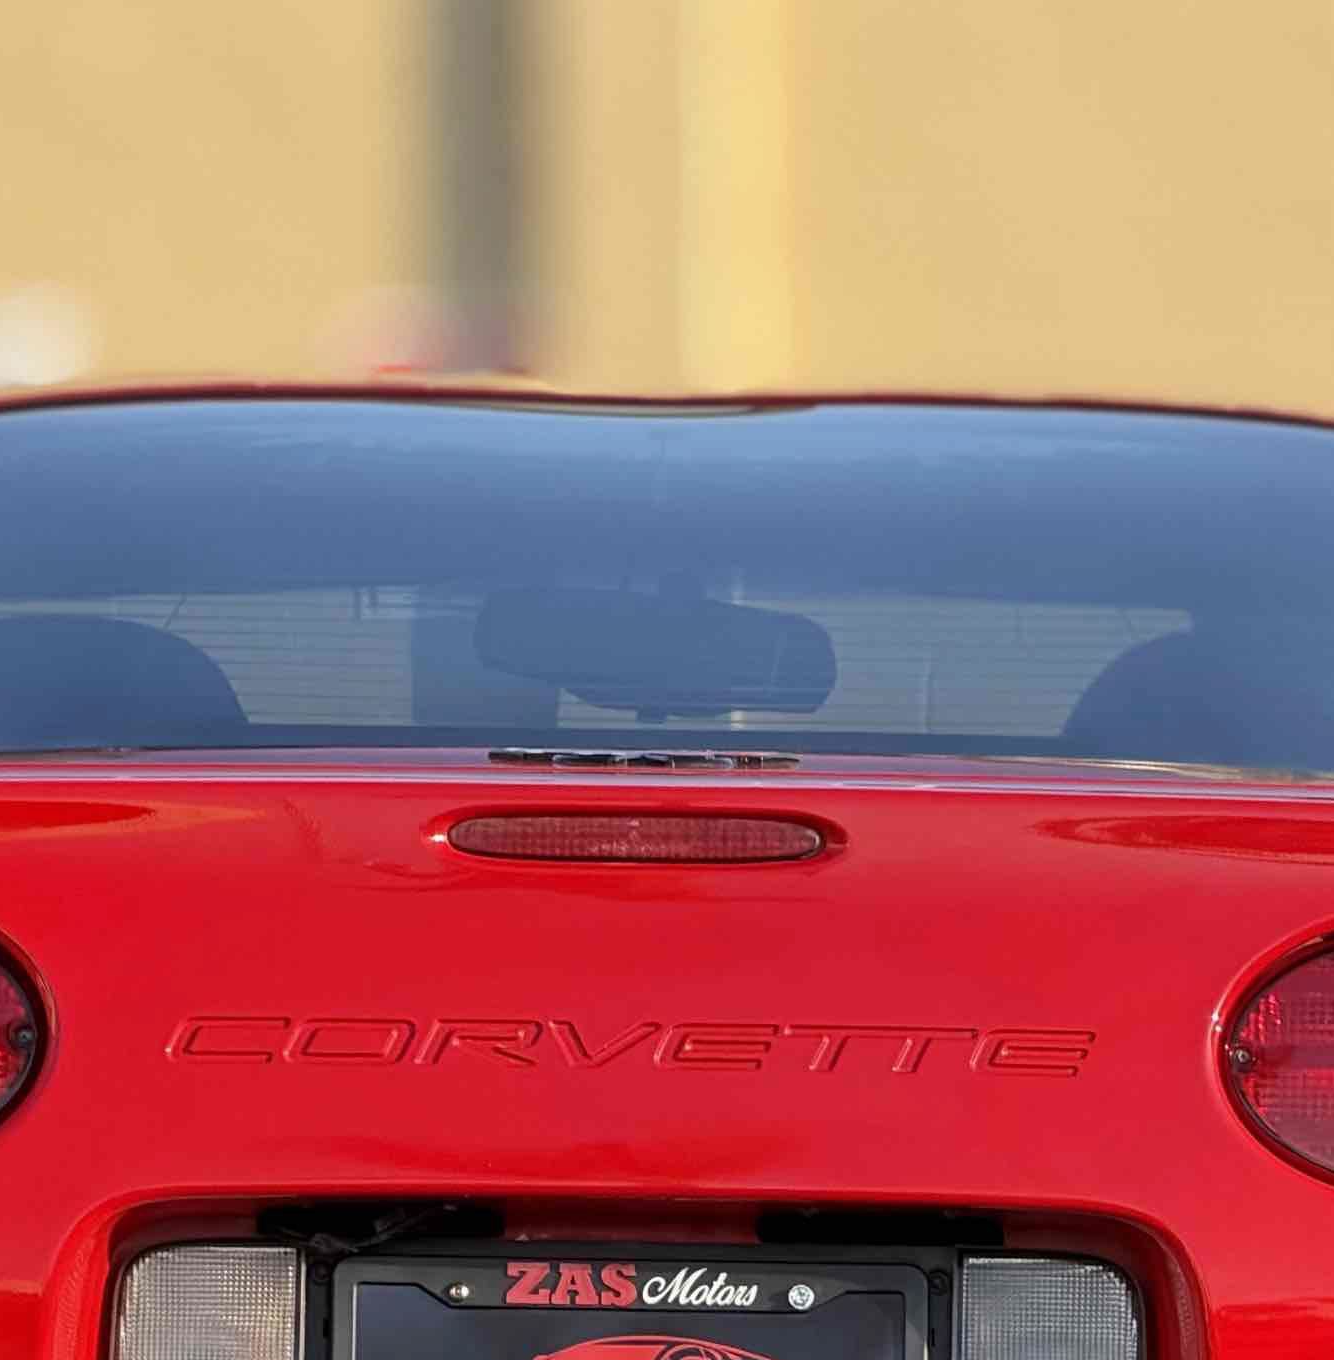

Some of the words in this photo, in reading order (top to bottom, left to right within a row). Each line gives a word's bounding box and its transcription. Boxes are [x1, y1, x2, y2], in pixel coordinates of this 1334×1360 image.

[164, 1015, 1096, 1077] CORVETTE
[506, 1262, 637, 1308] ZAS
[642, 1266, 759, 1308] Motors
